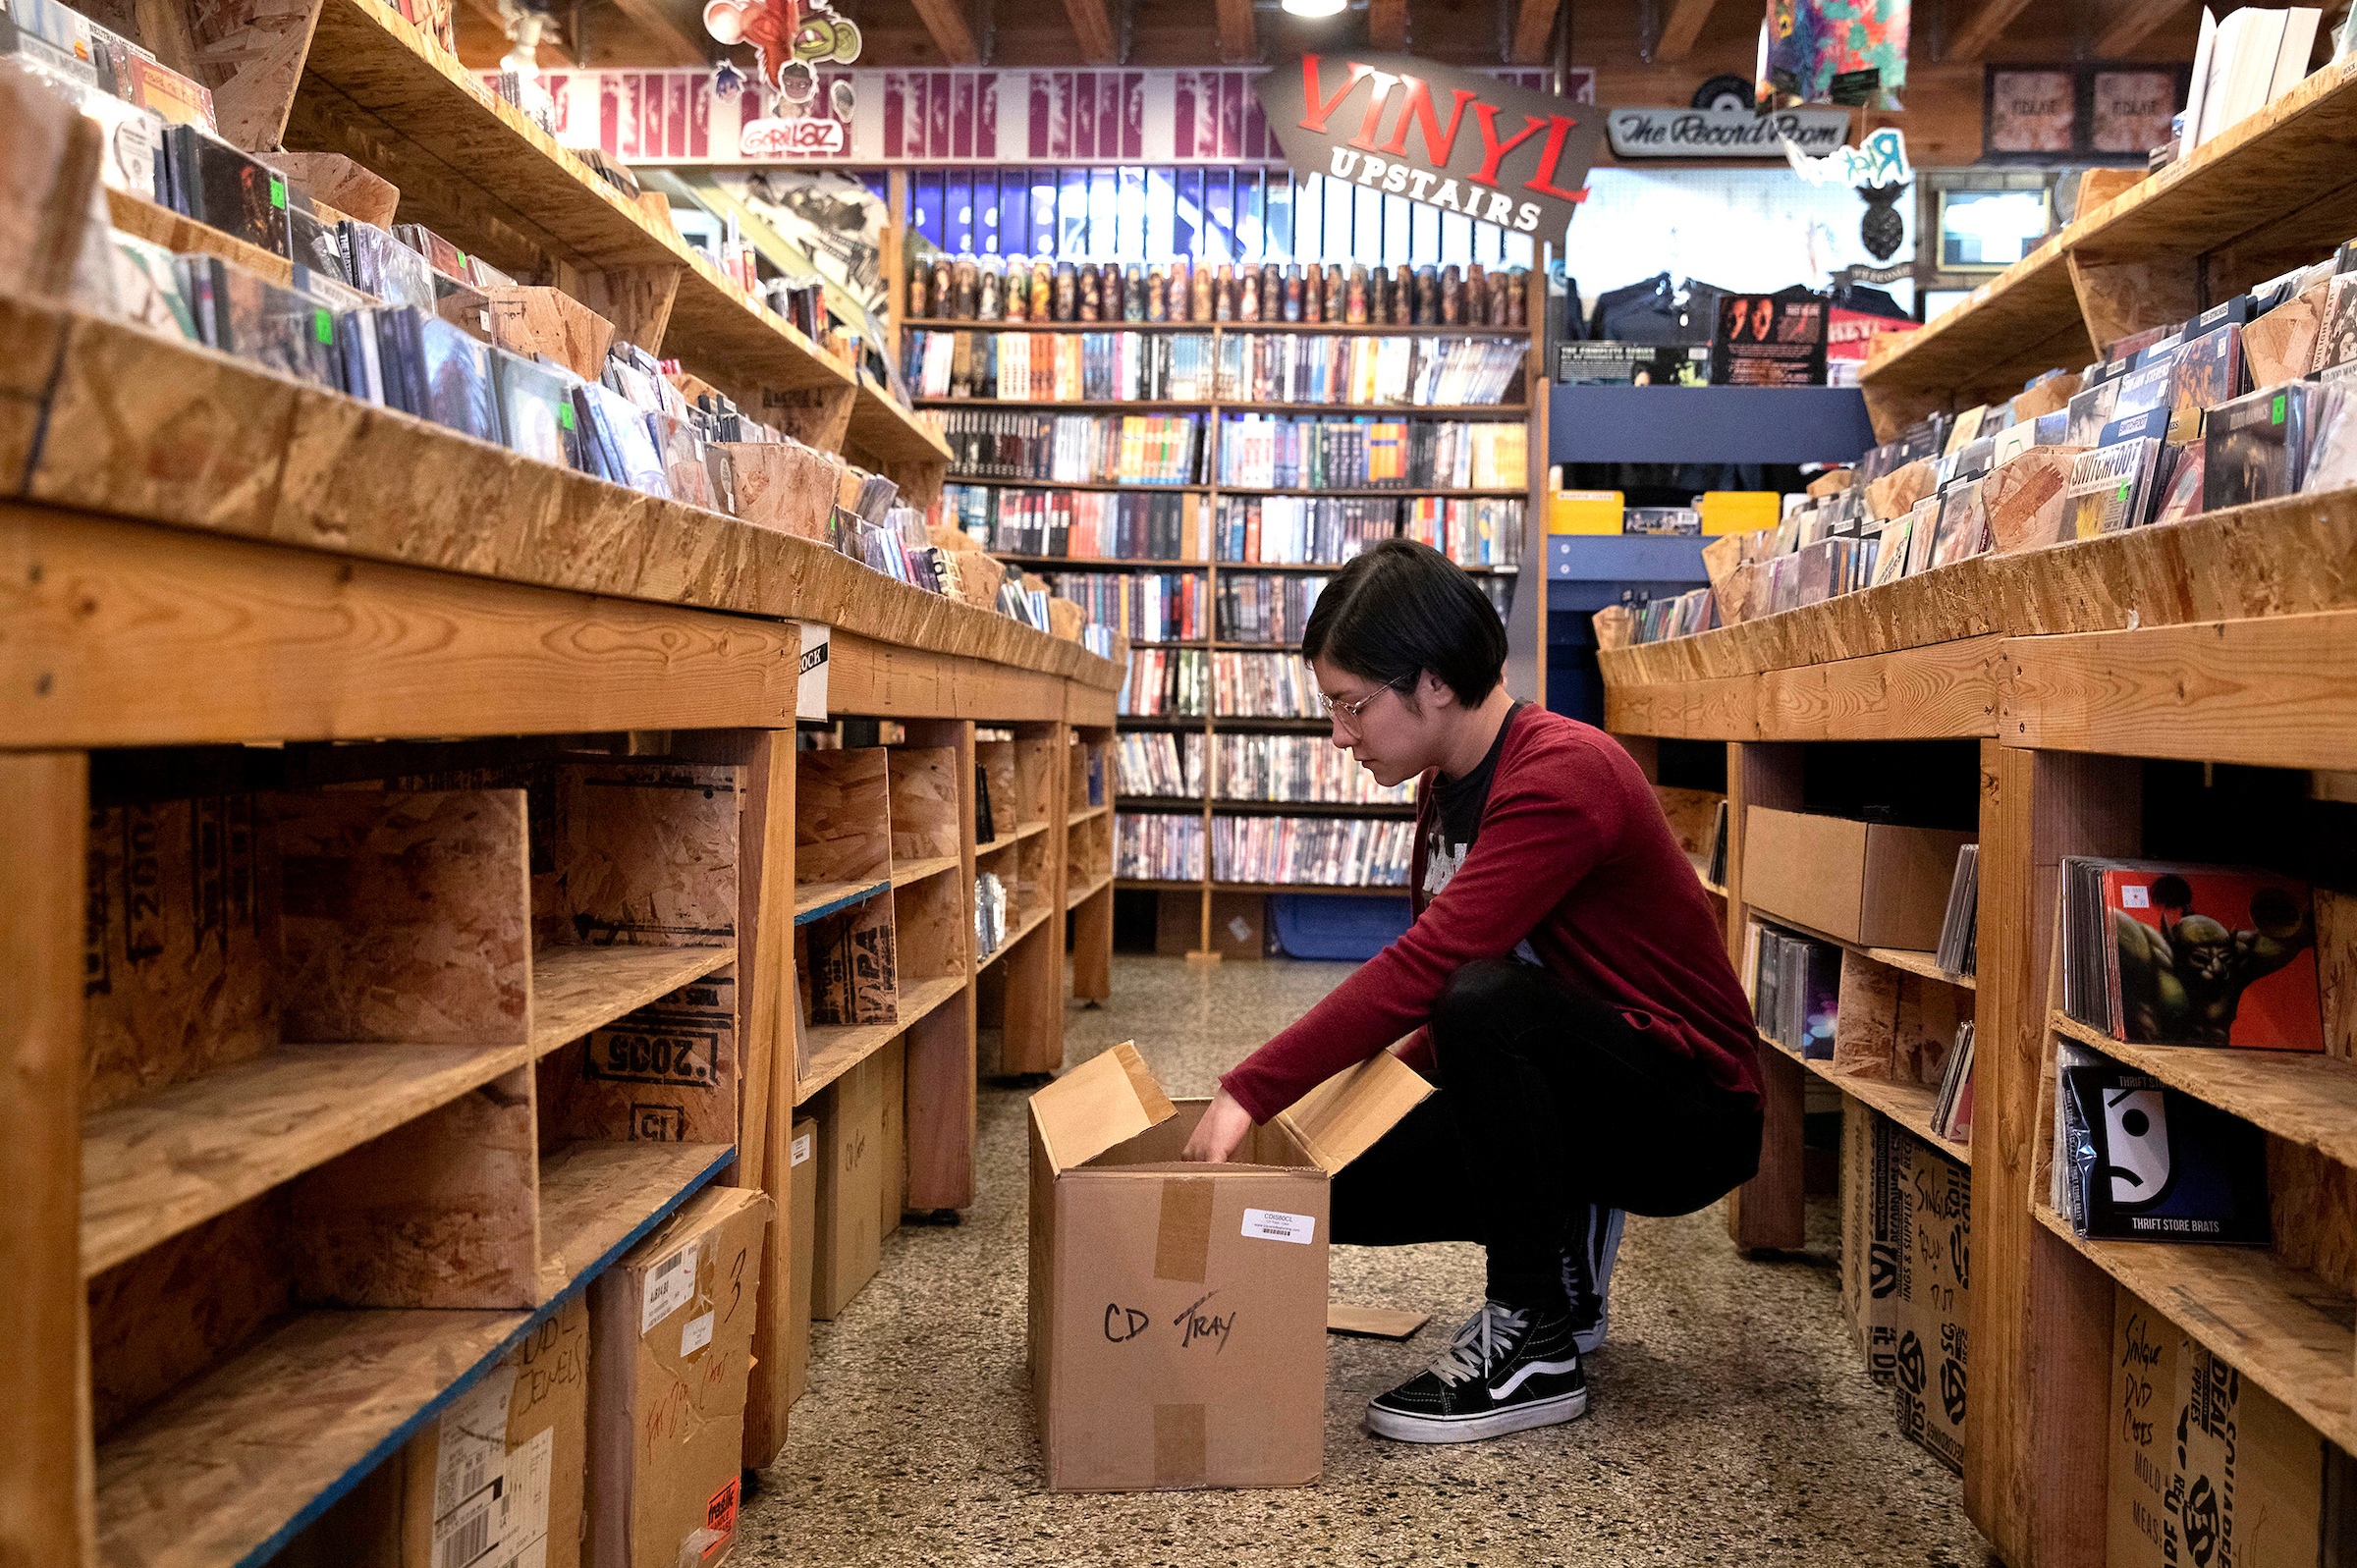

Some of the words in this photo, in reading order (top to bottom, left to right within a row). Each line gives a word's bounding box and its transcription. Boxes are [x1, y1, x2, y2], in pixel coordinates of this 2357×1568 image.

[1299, 53, 1592, 204] VINYL
[1619, 114, 1666, 143] The
[1670, 114, 1768, 145] Record
[1766, 114, 1839, 145] Room
[1330, 147, 1543, 232] UPSTAIRS
[2313, 321, 2329, 372] TWILIGHT
[2119, 415, 2149, 434] SWITCHFOOT
[607, 1034, 693, 1077] 2005
[2118, 1075, 2147, 1088] THRIFT
[1903, 1191, 1913, 1251] SUPPLIES
[2132, 1217, 2162, 1231] THRIFT
[2164, 1218, 2190, 1232] STORE
[2192, 1219, 2220, 1233] BRATS
[730, 1247, 746, 1325] 3
[1104, 1302, 1150, 1343] CD
[1173, 1288, 1236, 1356] TRAY
[2123, 1372, 2154, 1409] DVD
